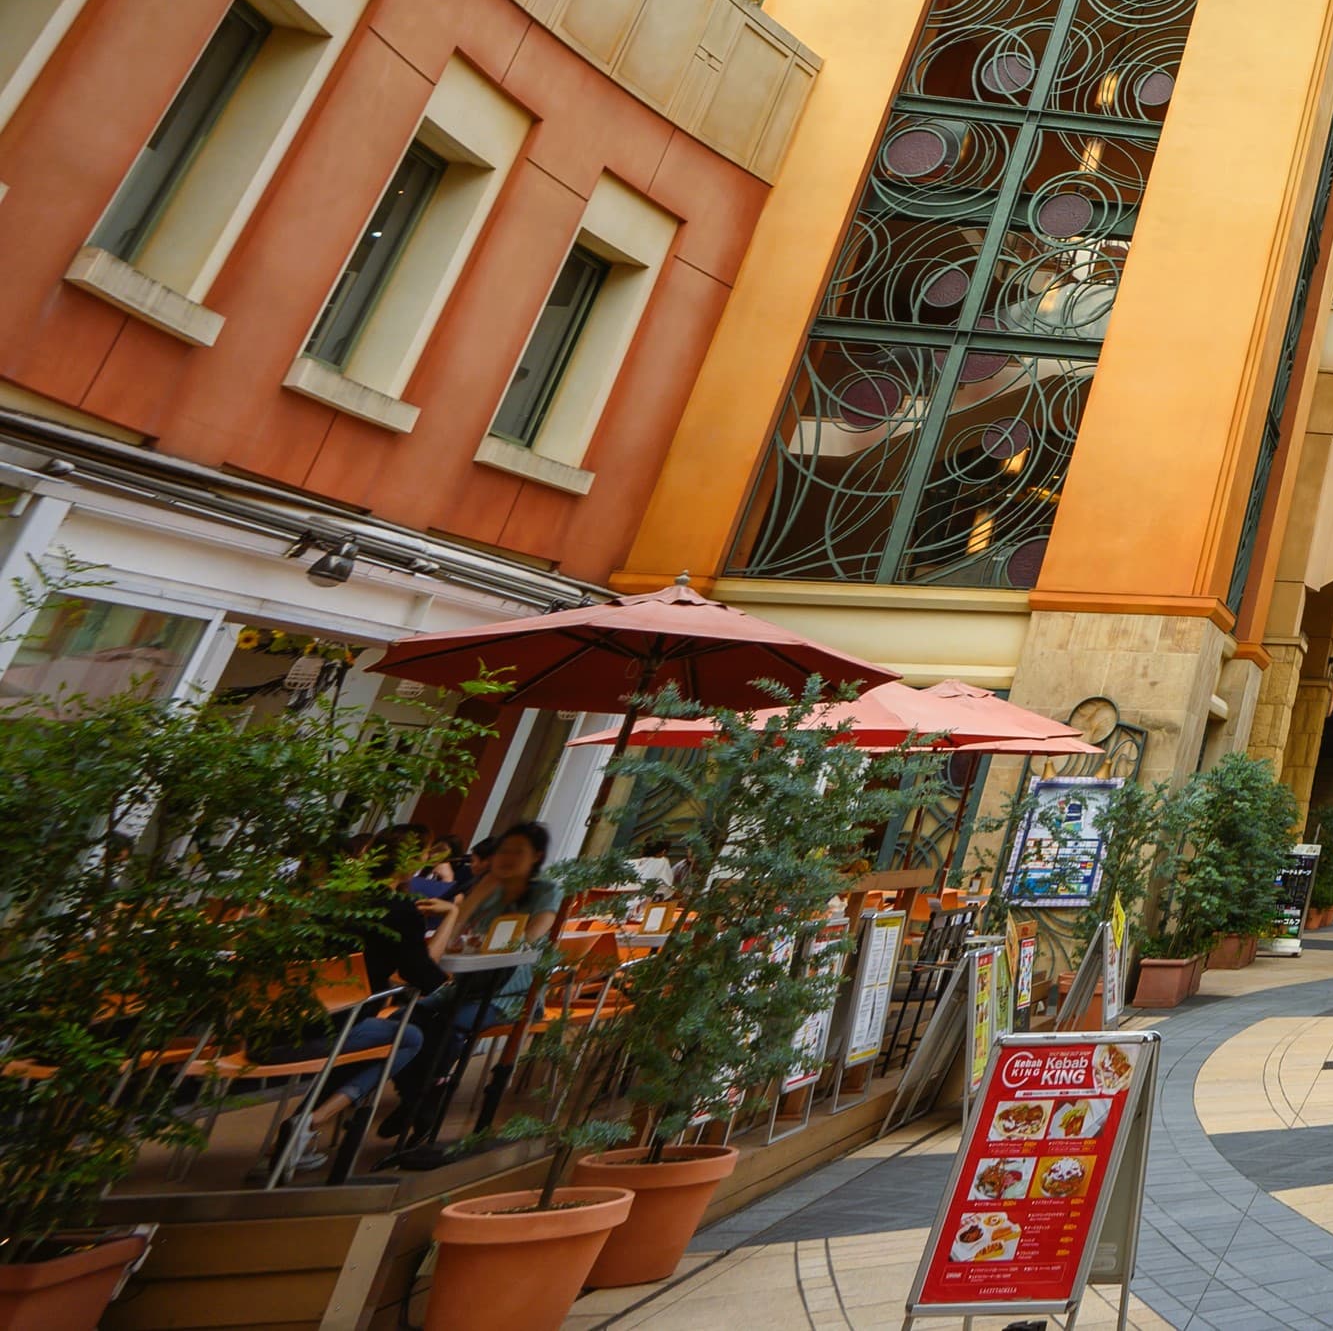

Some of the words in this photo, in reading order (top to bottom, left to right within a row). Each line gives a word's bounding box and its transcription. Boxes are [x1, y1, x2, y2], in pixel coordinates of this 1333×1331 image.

[1014, 1059, 1043, 1068] Kebab
[1045, 1056, 1089, 1070] Kebab
[1011, 1068, 1041, 1078] KING
[1040, 1069, 1086, 1086] KING
